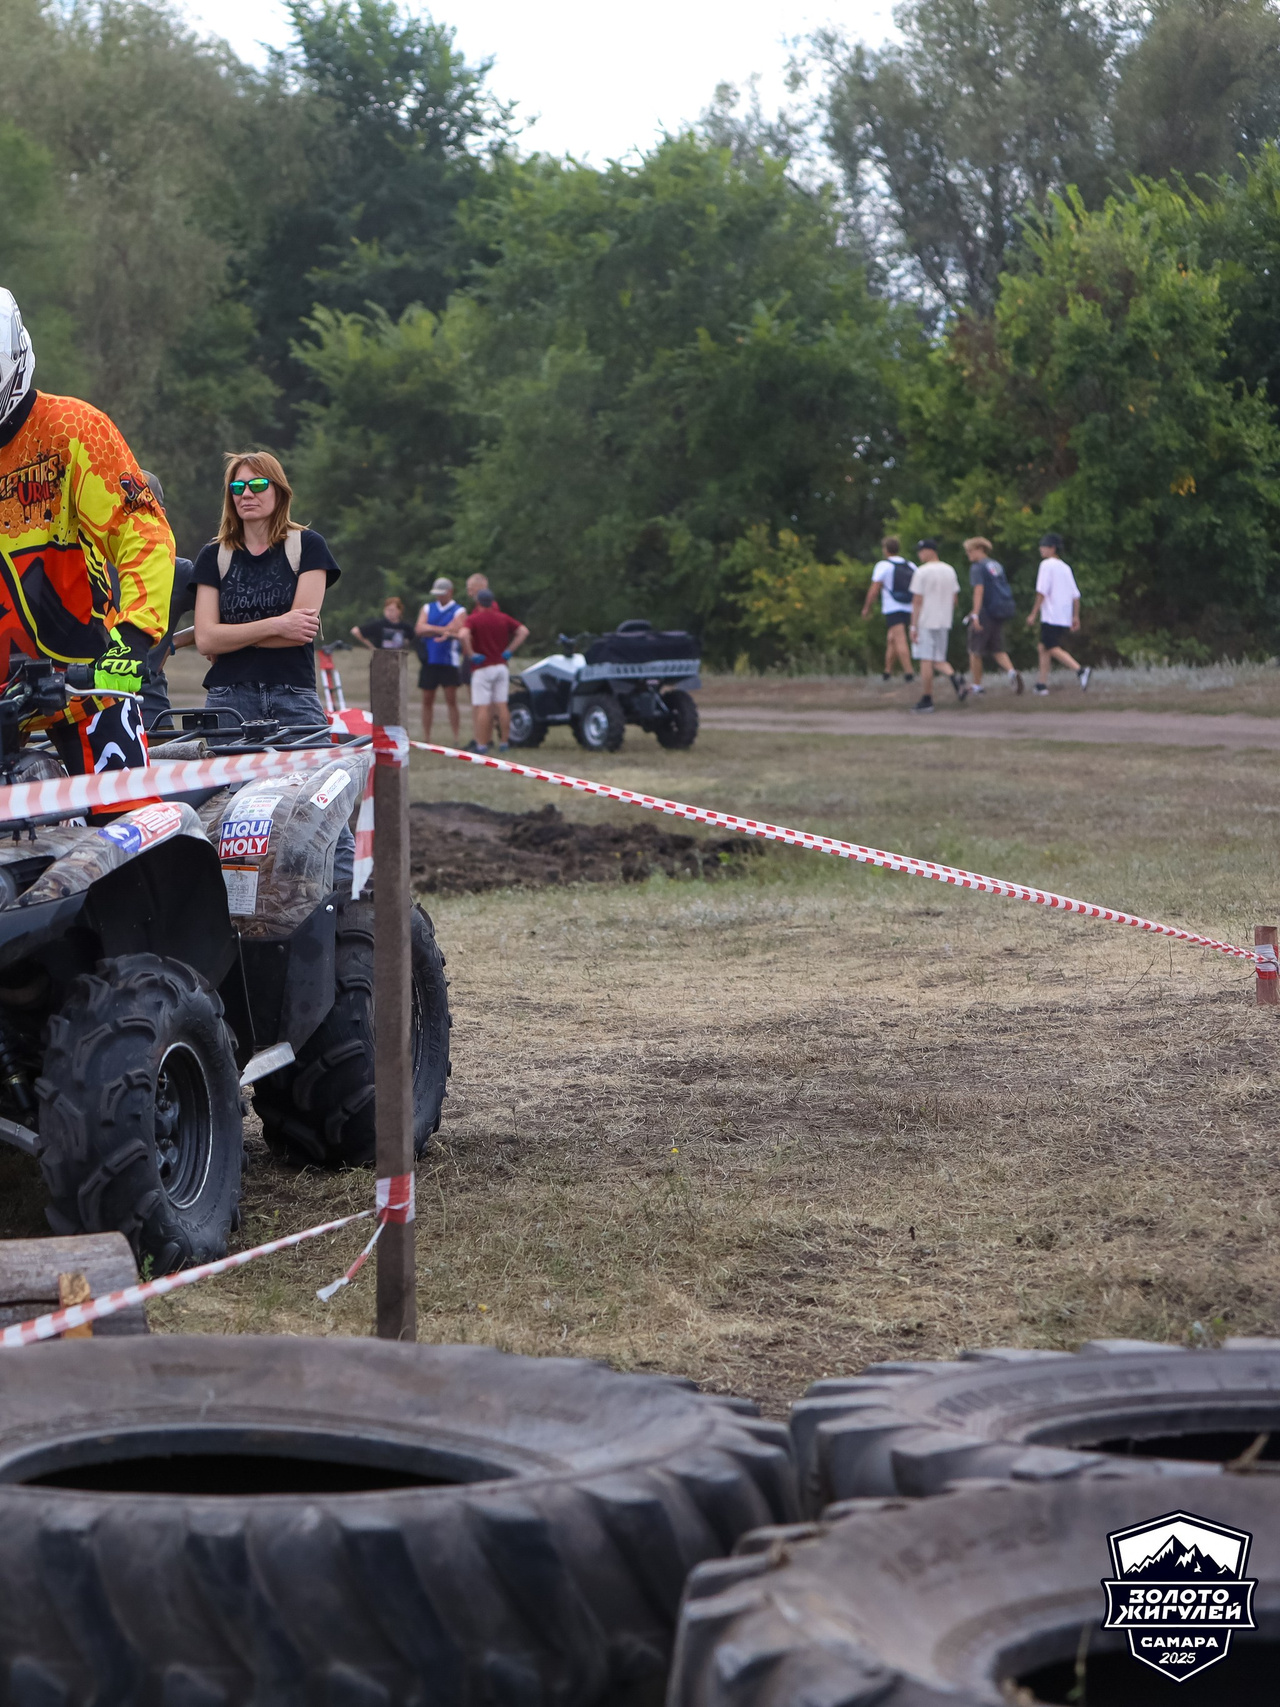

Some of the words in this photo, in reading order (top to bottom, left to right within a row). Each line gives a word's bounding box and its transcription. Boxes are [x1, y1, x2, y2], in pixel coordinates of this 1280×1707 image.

[101, 659, 142, 674] FOX
[223, 820, 270, 839] LIQUI
[221, 837, 268, 857] MOLY
